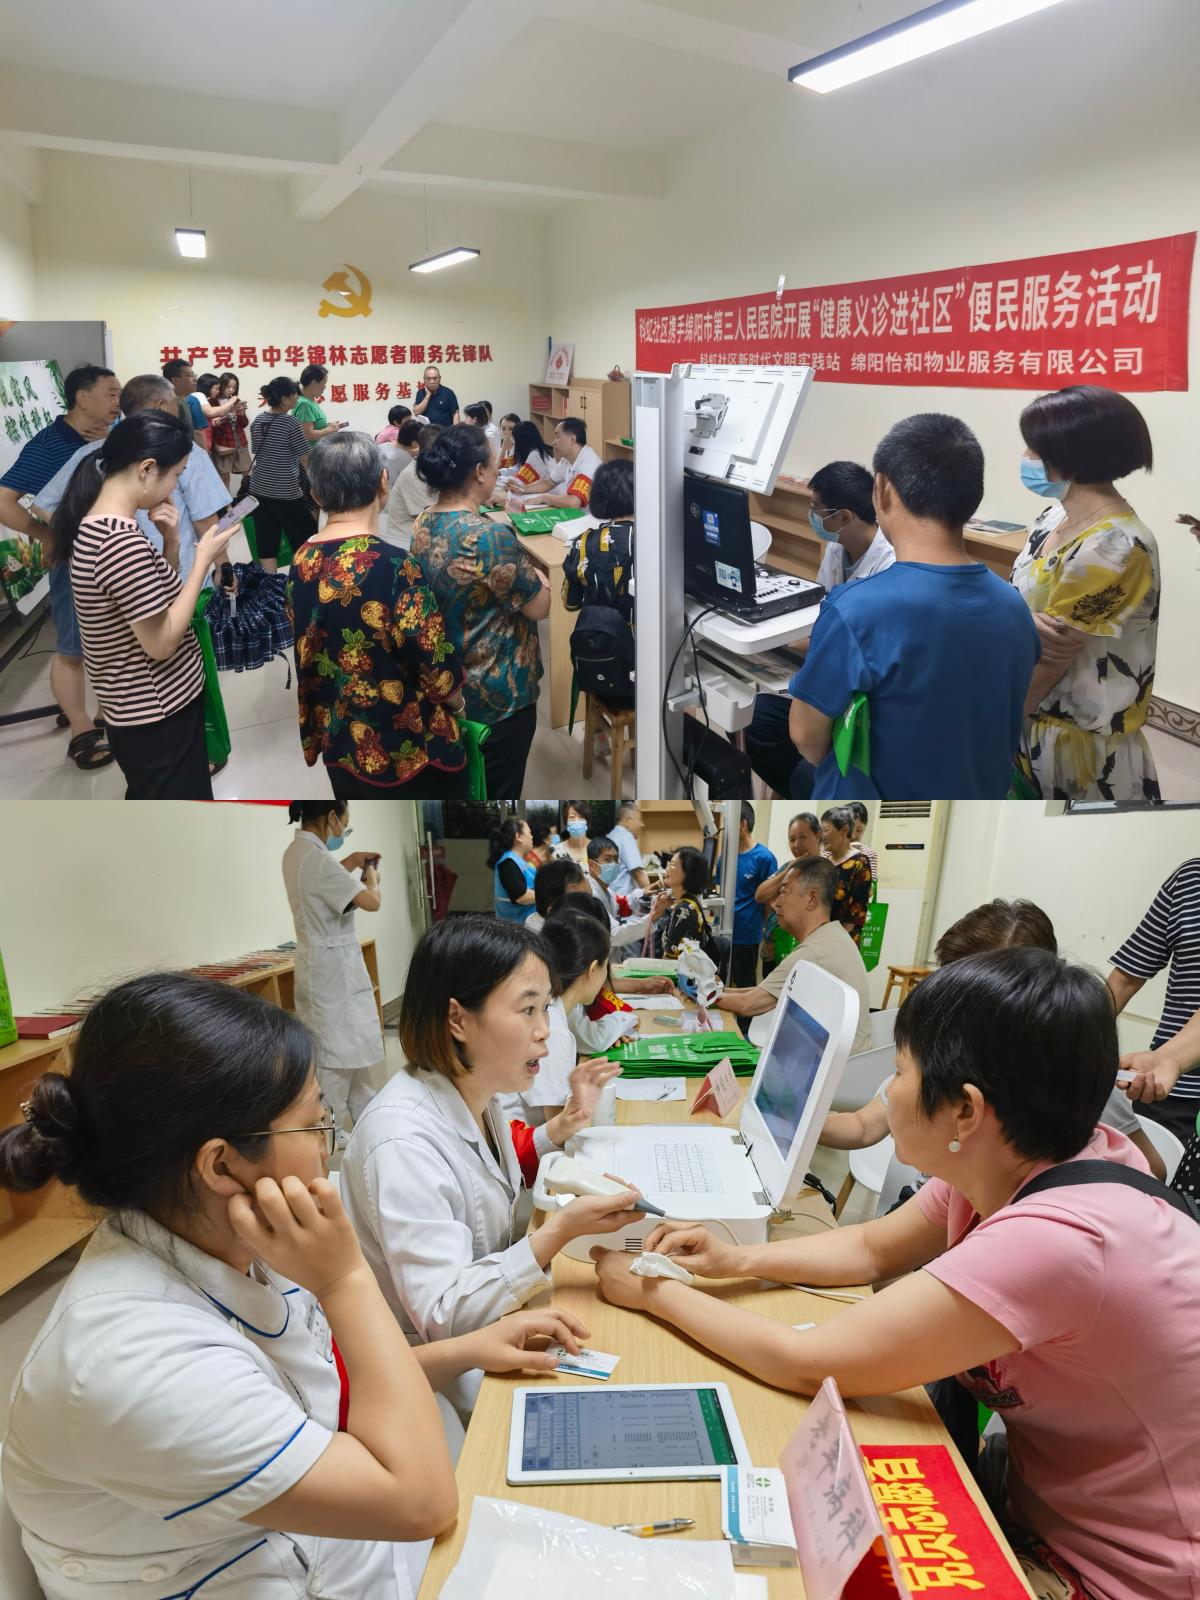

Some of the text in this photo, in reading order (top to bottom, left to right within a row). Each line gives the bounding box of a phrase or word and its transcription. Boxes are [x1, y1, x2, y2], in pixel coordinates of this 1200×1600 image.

[851, 347, 1143, 375] 绵阳怡和物业服务有限公司
